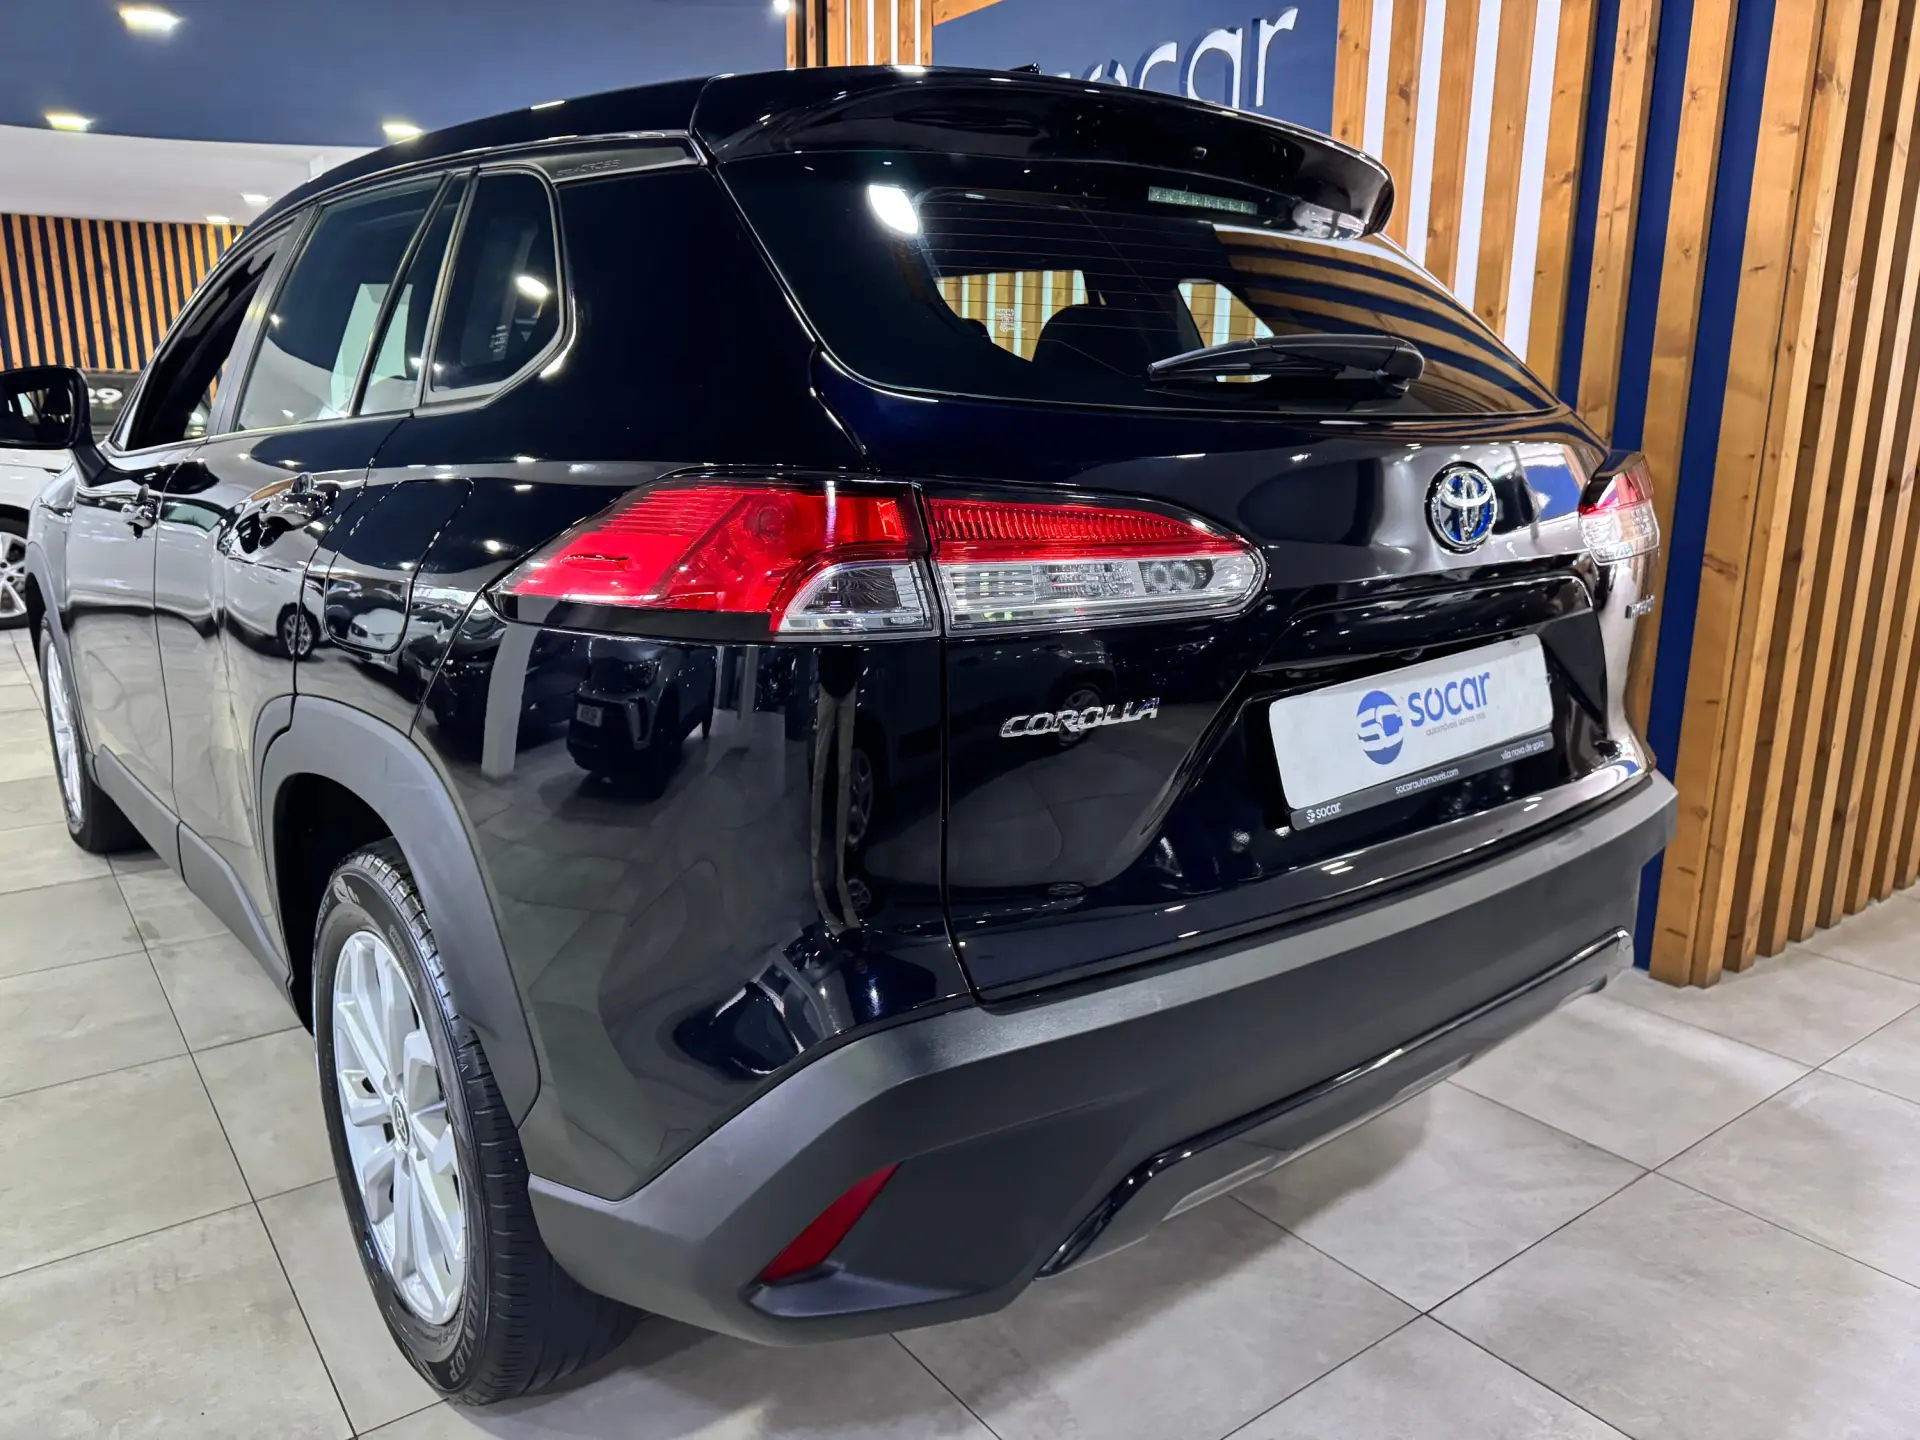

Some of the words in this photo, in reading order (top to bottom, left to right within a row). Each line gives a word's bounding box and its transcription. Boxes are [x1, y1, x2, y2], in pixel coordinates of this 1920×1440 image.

[1054, 7, 1298, 108] car
[999, 697, 1160, 737] COROLLA
[1407, 671, 1490, 727] socar
[1315, 802, 1342, 819] socar
